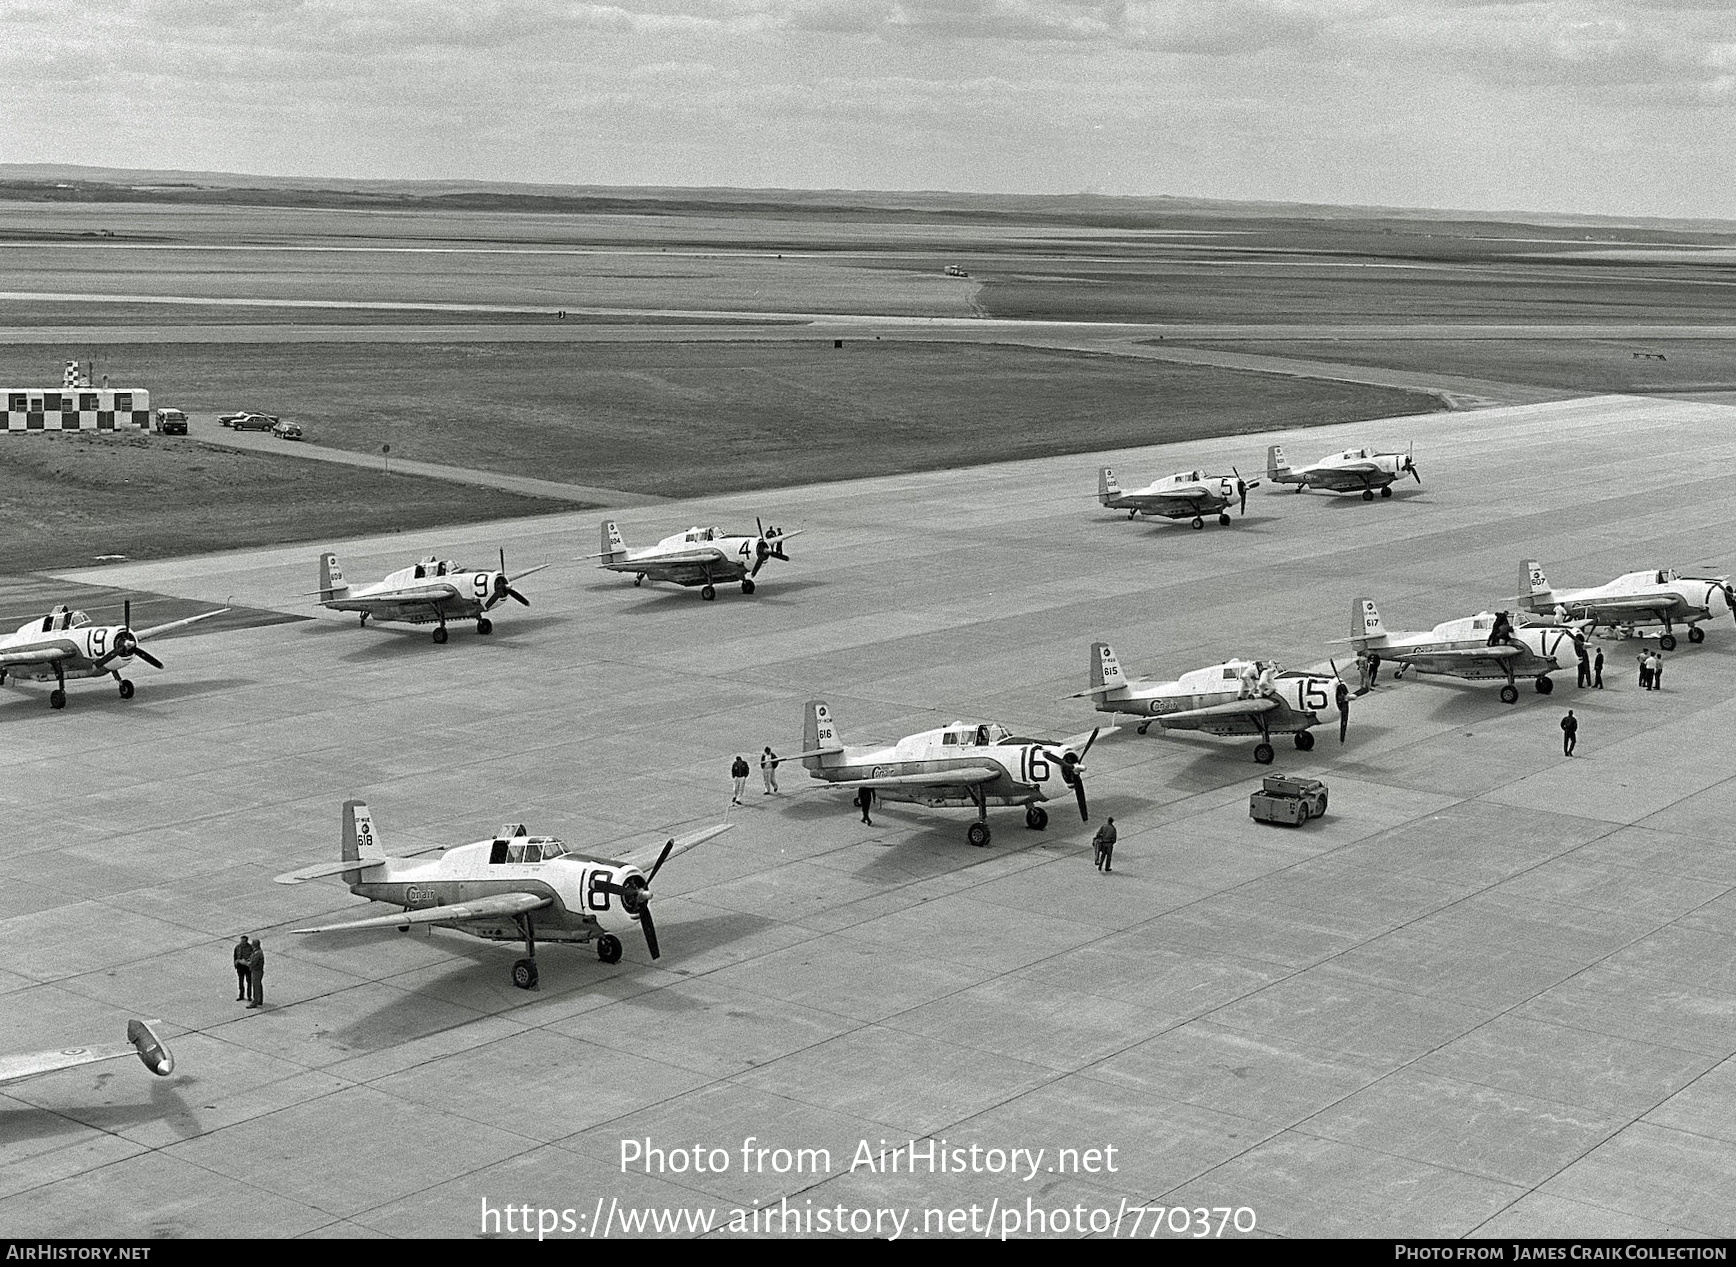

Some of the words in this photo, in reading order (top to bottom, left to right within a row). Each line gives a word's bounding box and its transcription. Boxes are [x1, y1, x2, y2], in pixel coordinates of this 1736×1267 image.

[1221, 478, 1232, 496] 5
[738, 540, 751, 560] 4
[473, 573, 489, 598] 9
[1531, 577, 1546, 586] 607
[1366, 618, 1379, 627] 617
[86, 628, 109, 657] 19
[1539, 629, 1567, 656] 17
[1103, 666, 1118, 676] 615
[1296, 678, 1329, 710] 15
[819, 728, 832, 740] 616
[1019, 745, 1050, 782] 16
[357, 834, 373, 846] 618
[404, 884, 436, 905] Conair
[579, 868, 614, 911] 18
